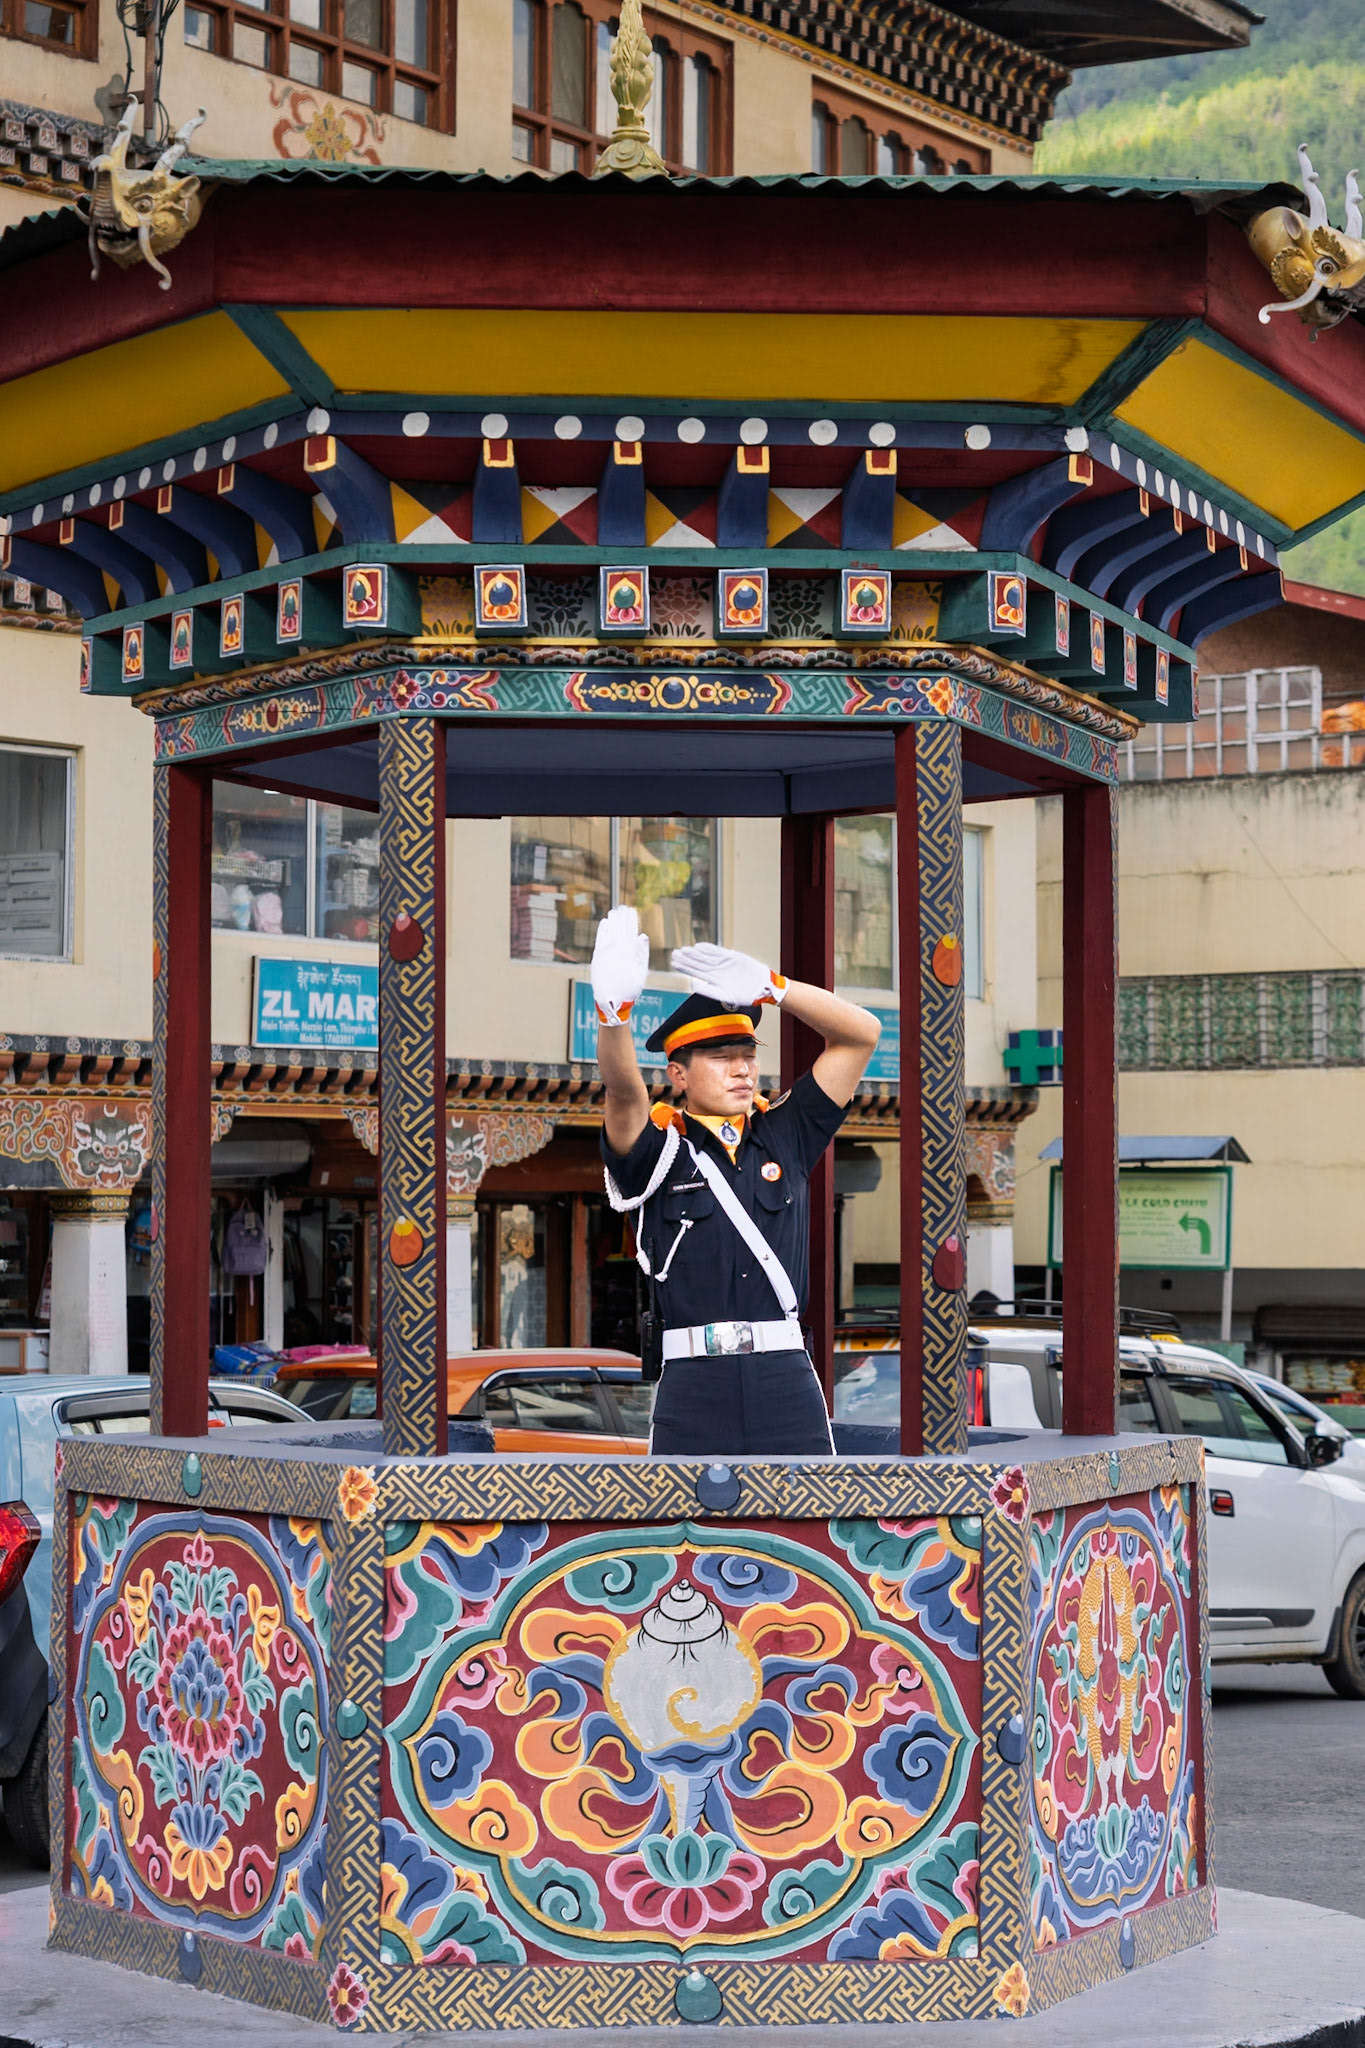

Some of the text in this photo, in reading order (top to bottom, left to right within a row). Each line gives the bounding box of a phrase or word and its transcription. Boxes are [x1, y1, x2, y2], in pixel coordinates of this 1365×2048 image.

[262, 990, 379, 1022] ZL MAR
[261, 1020, 278, 1031] Main
[1142, 1198, 1171, 1208] COLD
